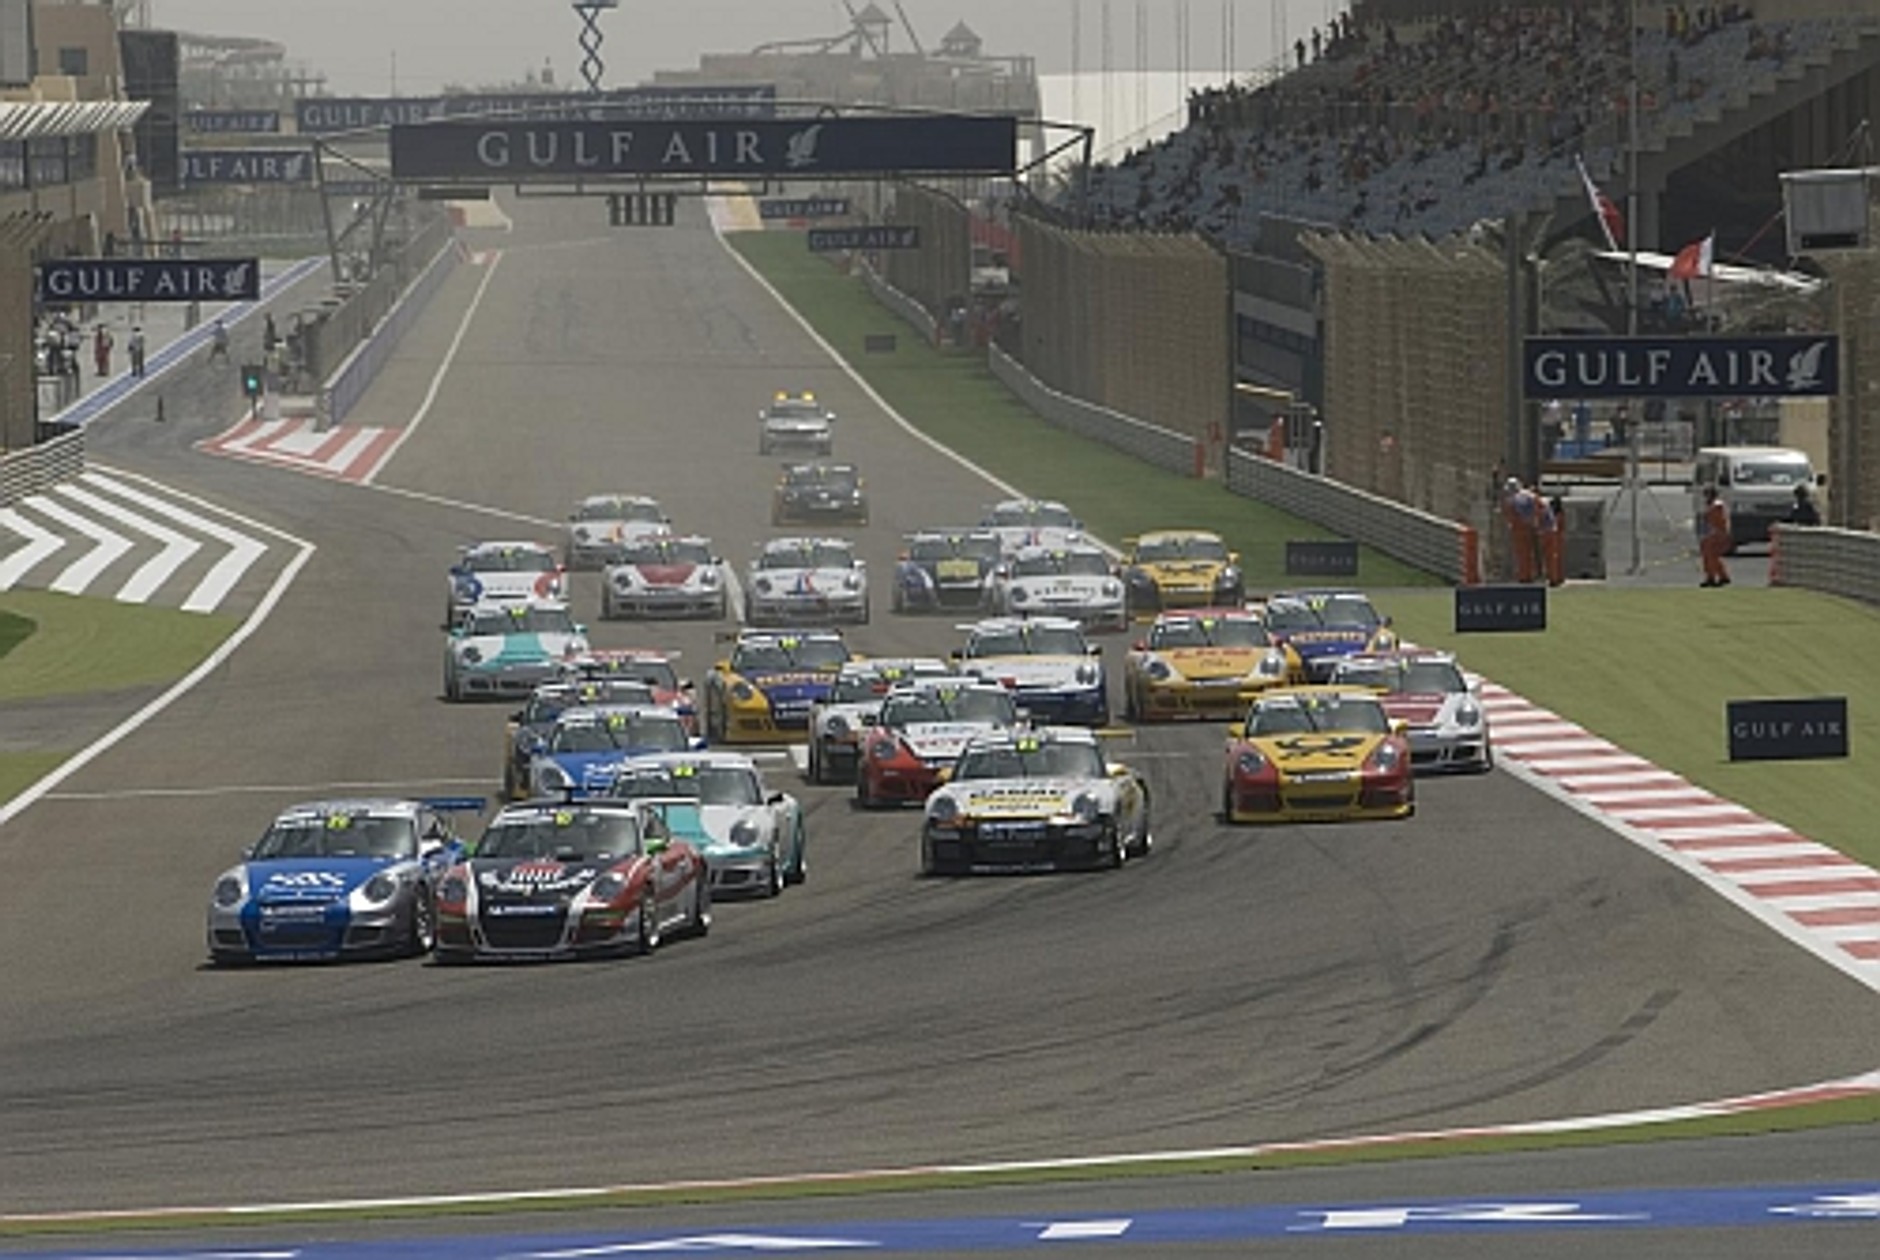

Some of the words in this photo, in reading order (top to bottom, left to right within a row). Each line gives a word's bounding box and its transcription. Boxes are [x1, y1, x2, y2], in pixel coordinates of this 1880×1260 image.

[304, 105, 368, 126] GULF
[378, 105, 425, 125] AIR
[477, 131, 634, 166] GULF
[661, 132, 764, 164] AIR
[230, 157, 280, 178] AIR
[865, 230, 897, 246] AIR
[49, 268, 144, 295] GULF
[154, 268, 216, 294] AIR
[1534, 351, 1671, 386] GULF
[1688, 351, 1780, 386] AIR
[1734, 721, 1793, 739] GULF
[1801, 720, 1840, 736] AIR
